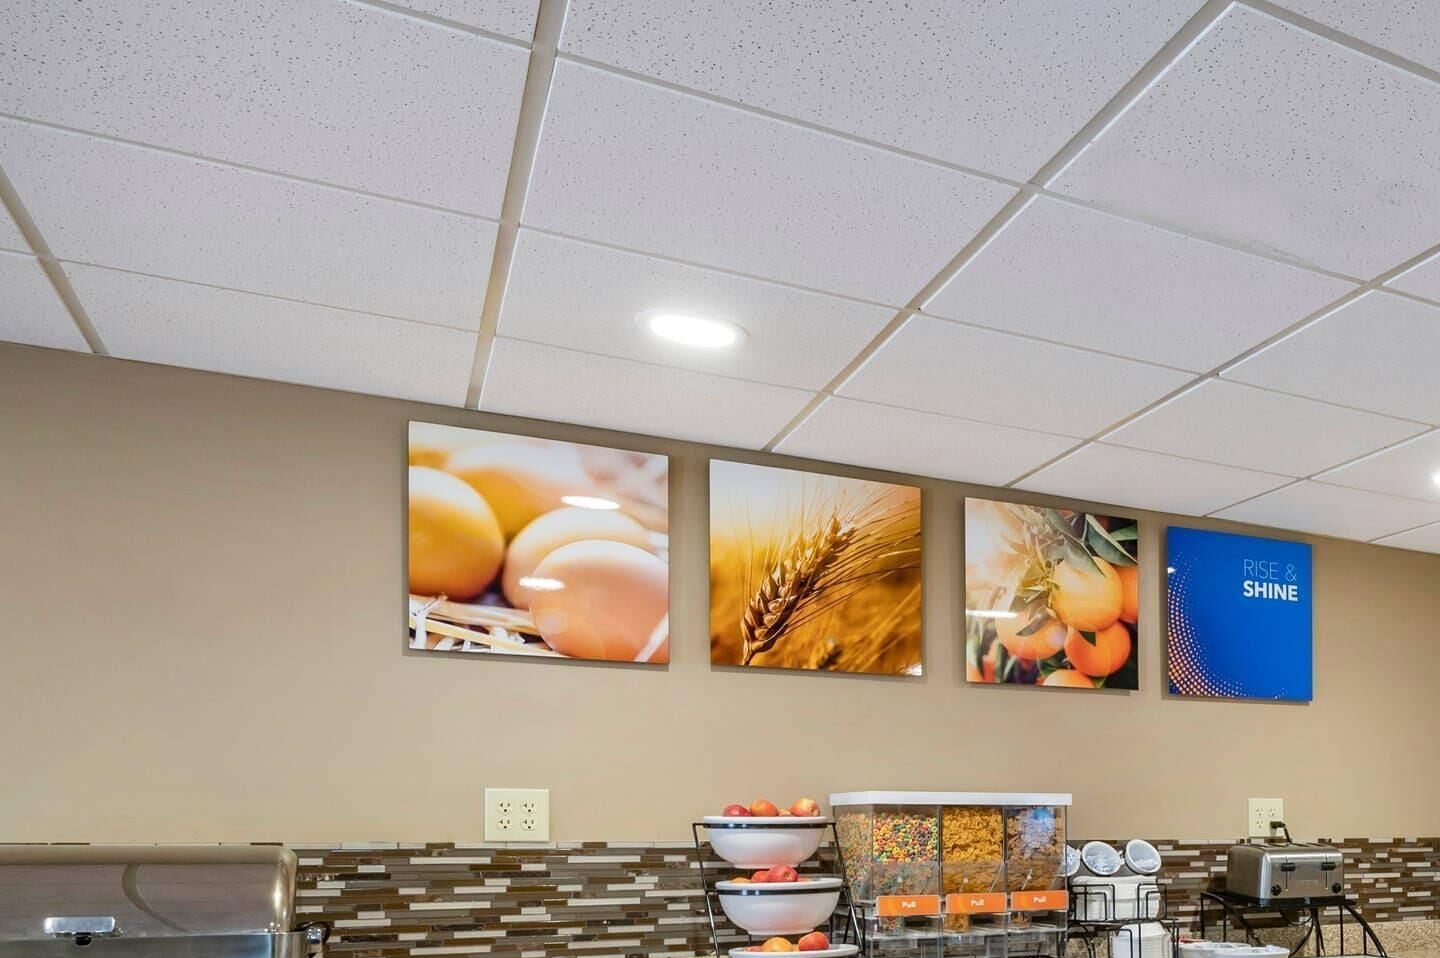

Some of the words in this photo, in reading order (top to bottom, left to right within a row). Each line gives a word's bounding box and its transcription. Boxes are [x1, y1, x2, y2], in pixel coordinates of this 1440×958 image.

[1243, 559, 1279, 580] RISE
[1285, 563, 1297, 582] &
[1243, 580, 1298, 601] SHINE
[970, 899, 985, 907] Pull
[1033, 895, 1047, 904] Pull
[902, 900, 917, 909] Pull
